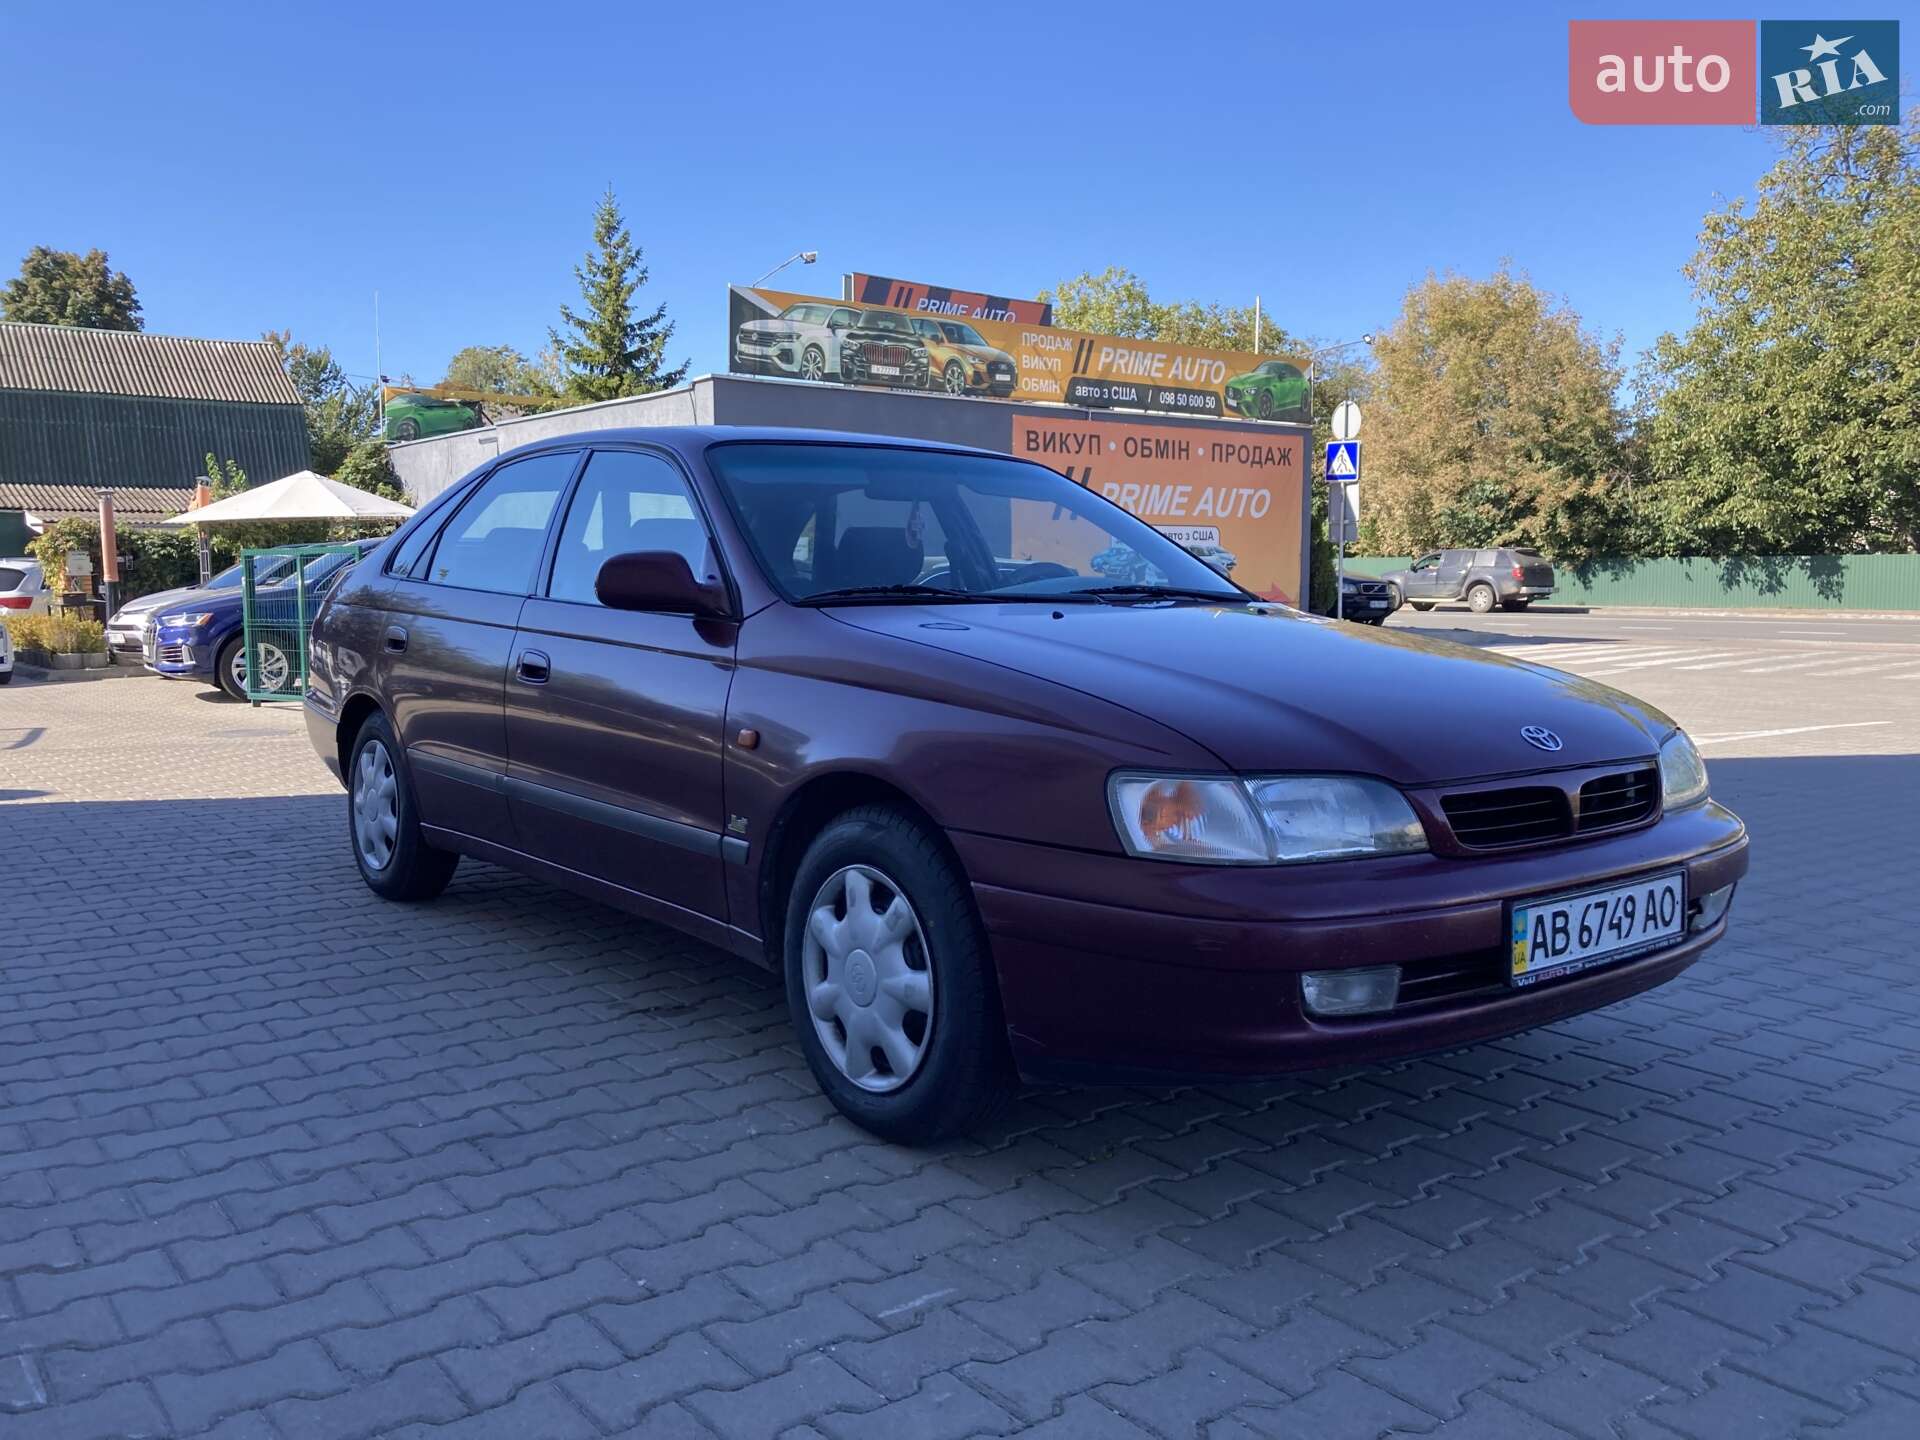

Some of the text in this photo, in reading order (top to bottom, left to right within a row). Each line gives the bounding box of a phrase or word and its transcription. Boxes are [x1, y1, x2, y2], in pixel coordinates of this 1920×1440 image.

[917, 298, 1017, 323] PRIME AUTO
[1022, 332, 1073, 352] ПРОДАЖ
[1022, 354, 1062, 373] ВИКУП
[1098, 346, 1226, 385] PRIME AUTO
[1022, 377, 1061, 393] ОБМІН
[1075, 385, 1101, 398] авто
[1103, 388, 1109, 399] з
[1111, 385, 1138, 401] США
[1160, 391, 1176, 405] 098
[1177, 393, 1187, 406] 50
[1189, 394, 1204, 407] 600
[1205, 396, 1216, 409] 50
[1026, 429, 1293, 466] ВИКУП ОБМІН ПРОДАЖ
[1102, 482, 1272, 519] PRIME AUTO
[1192, 530, 1215, 541] США
[1530, 909, 1570, 962] AB
[1578, 894, 1636, 949] 6749
[1643, 885, 1676, 934] AO
[1514, 951, 1526, 966] UA
